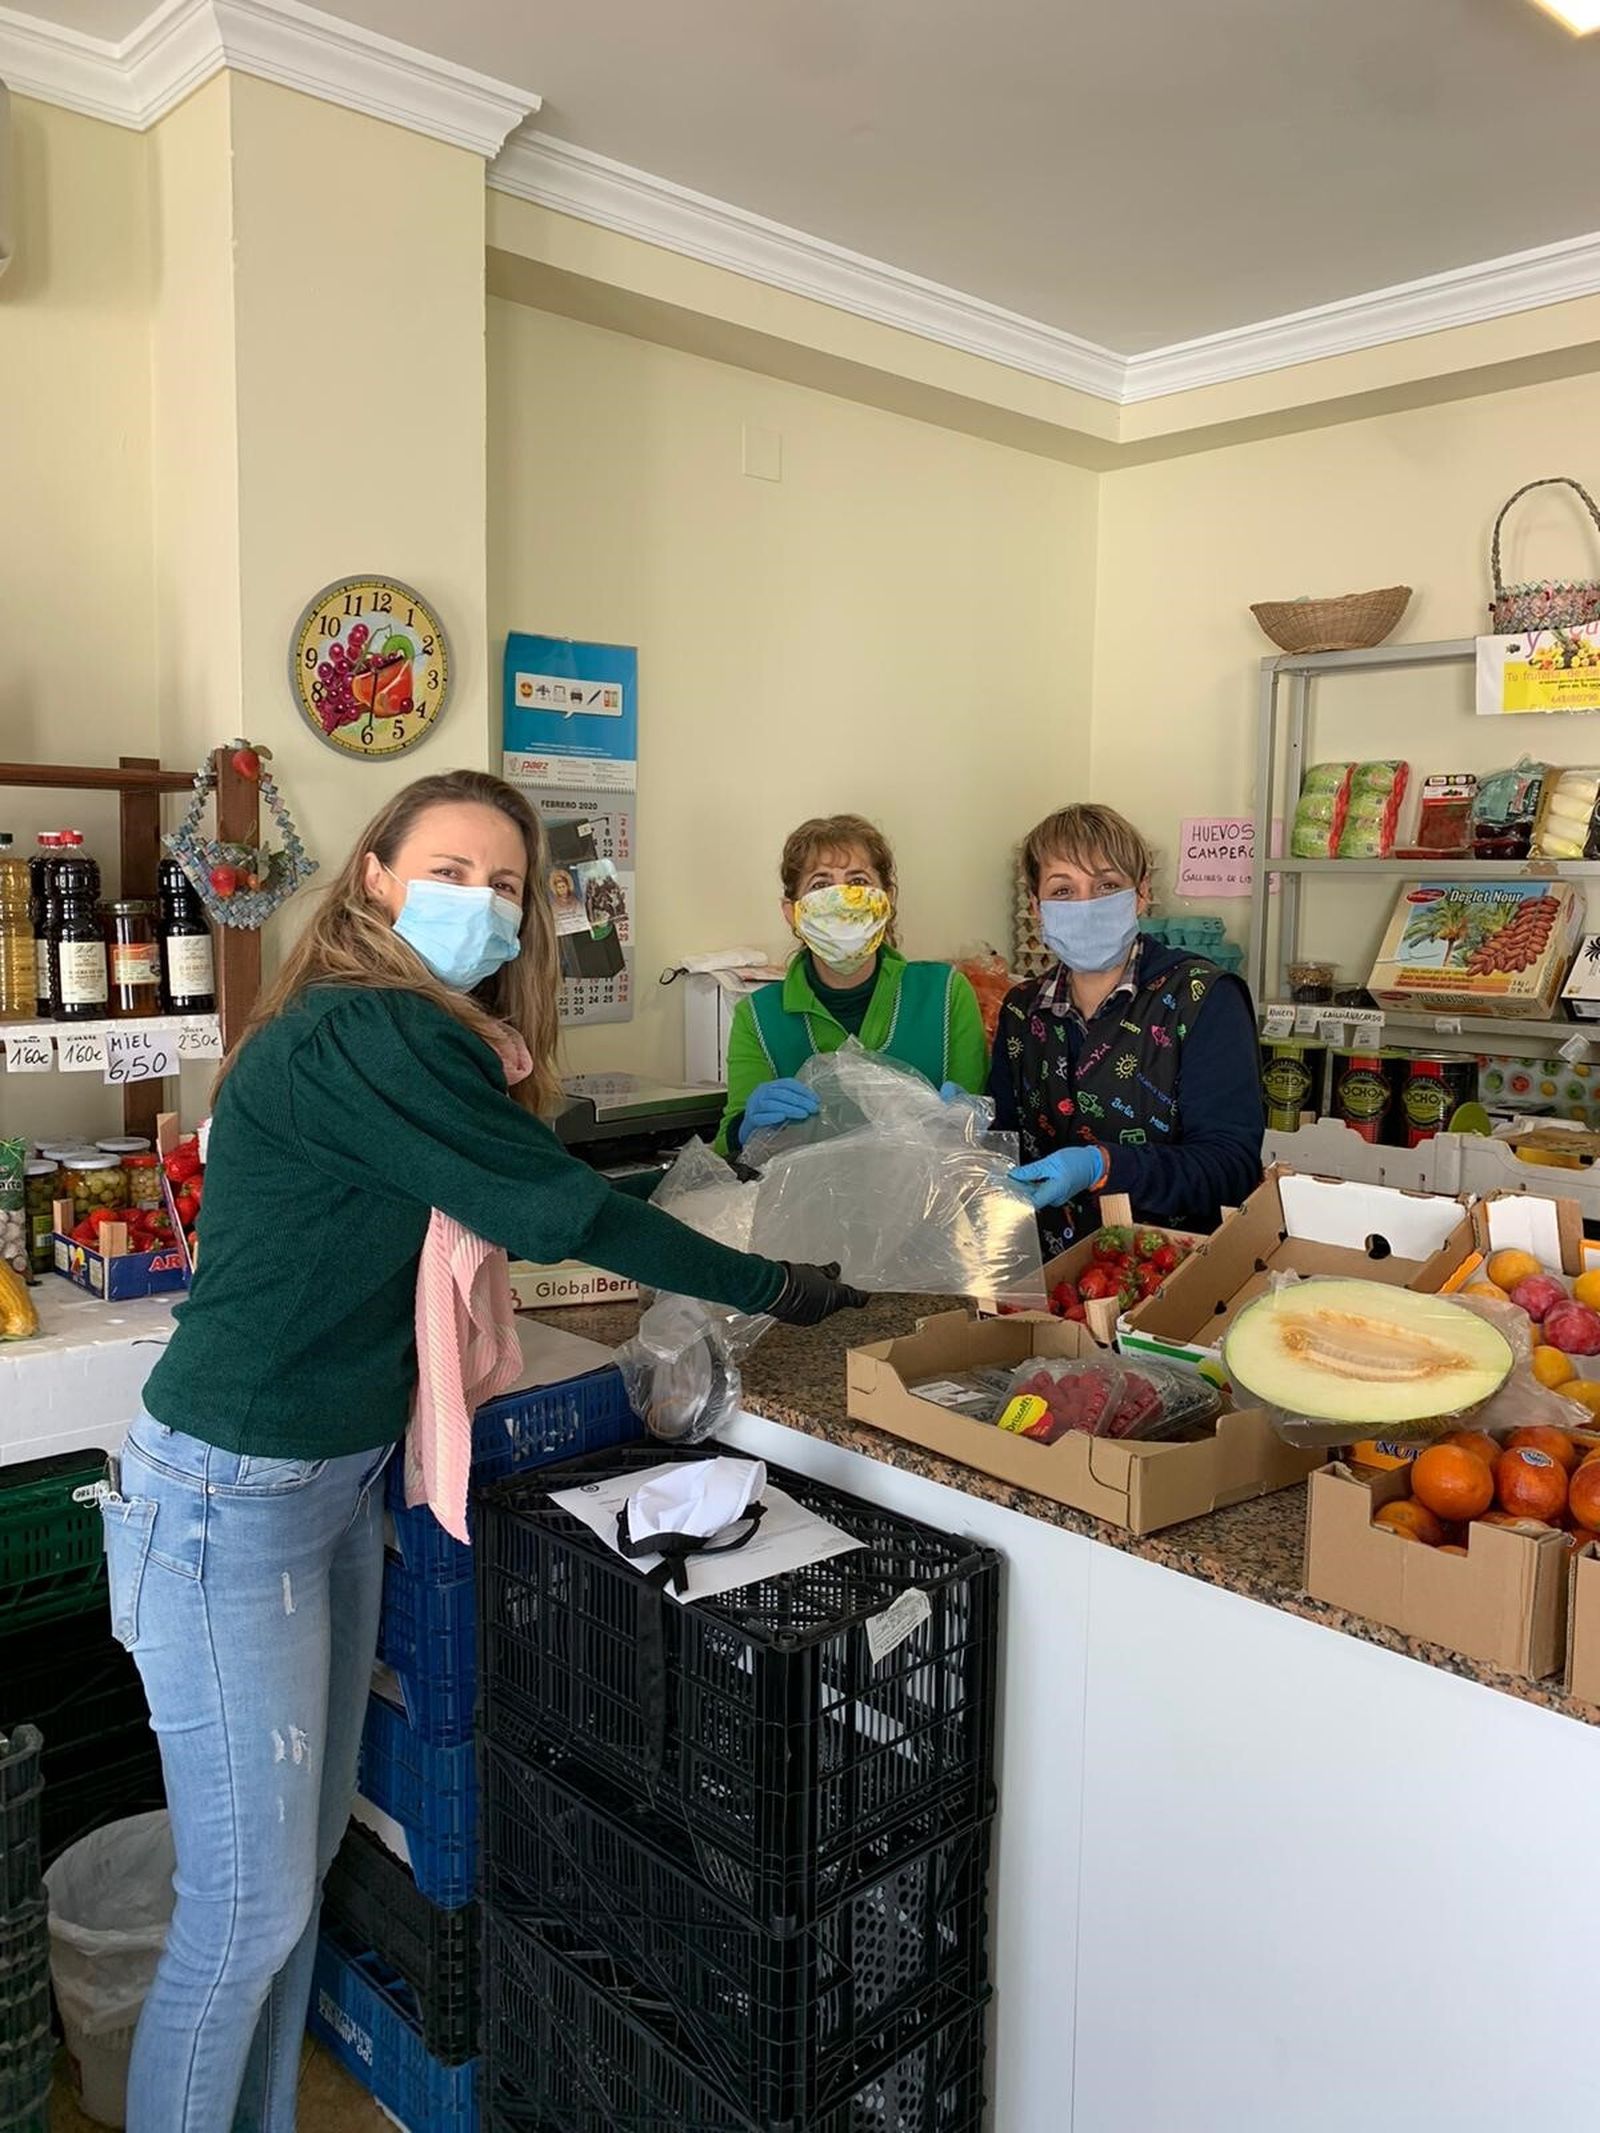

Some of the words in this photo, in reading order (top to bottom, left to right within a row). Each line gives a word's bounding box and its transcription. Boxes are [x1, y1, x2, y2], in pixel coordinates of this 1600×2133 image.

[344, 594, 363, 617] 11
[371, 592, 392, 613] 12
[319, 615, 341, 638] 10
[406, 609, 413, 627] 1
[422, 635, 434, 656] 2
[305, 648, 318, 670] 9
[427, 670, 439, 690] 3
[311, 681, 324, 703] 8
[416, 701, 427, 718] 4
[361, 725, 374, 745] 6
[392, 719, 405, 739] 5
[541, 800, 577, 809] FEBRERO
[578, 802, 598, 810] 2020
[1192, 823, 1255, 841] HUEVOS
[603, 839, 613, 847] 15
[603, 849, 613, 858] 22
[618, 849, 629, 858] 23
[1449, 889, 1490, 904] Deglet
[1492, 890, 1522, 902] Nour
[574, 986, 584, 994] 16
[589, 986, 599, 994] 17
[604, 985, 614, 993] 18
[558, 997, 568, 1005] 22
[574, 997, 584, 1005] 23
[588, 996, 599, 1004] 24
[603, 995, 614, 1003] 25
[574, 1007, 585, 1016] 30
[111, 1033, 152, 1052] MIEL
[109, 1052, 167, 1082] 6,50
[1264, 1075, 1307, 1087] OCHOA
[1342, 1086, 1386, 1098] OCHOA
